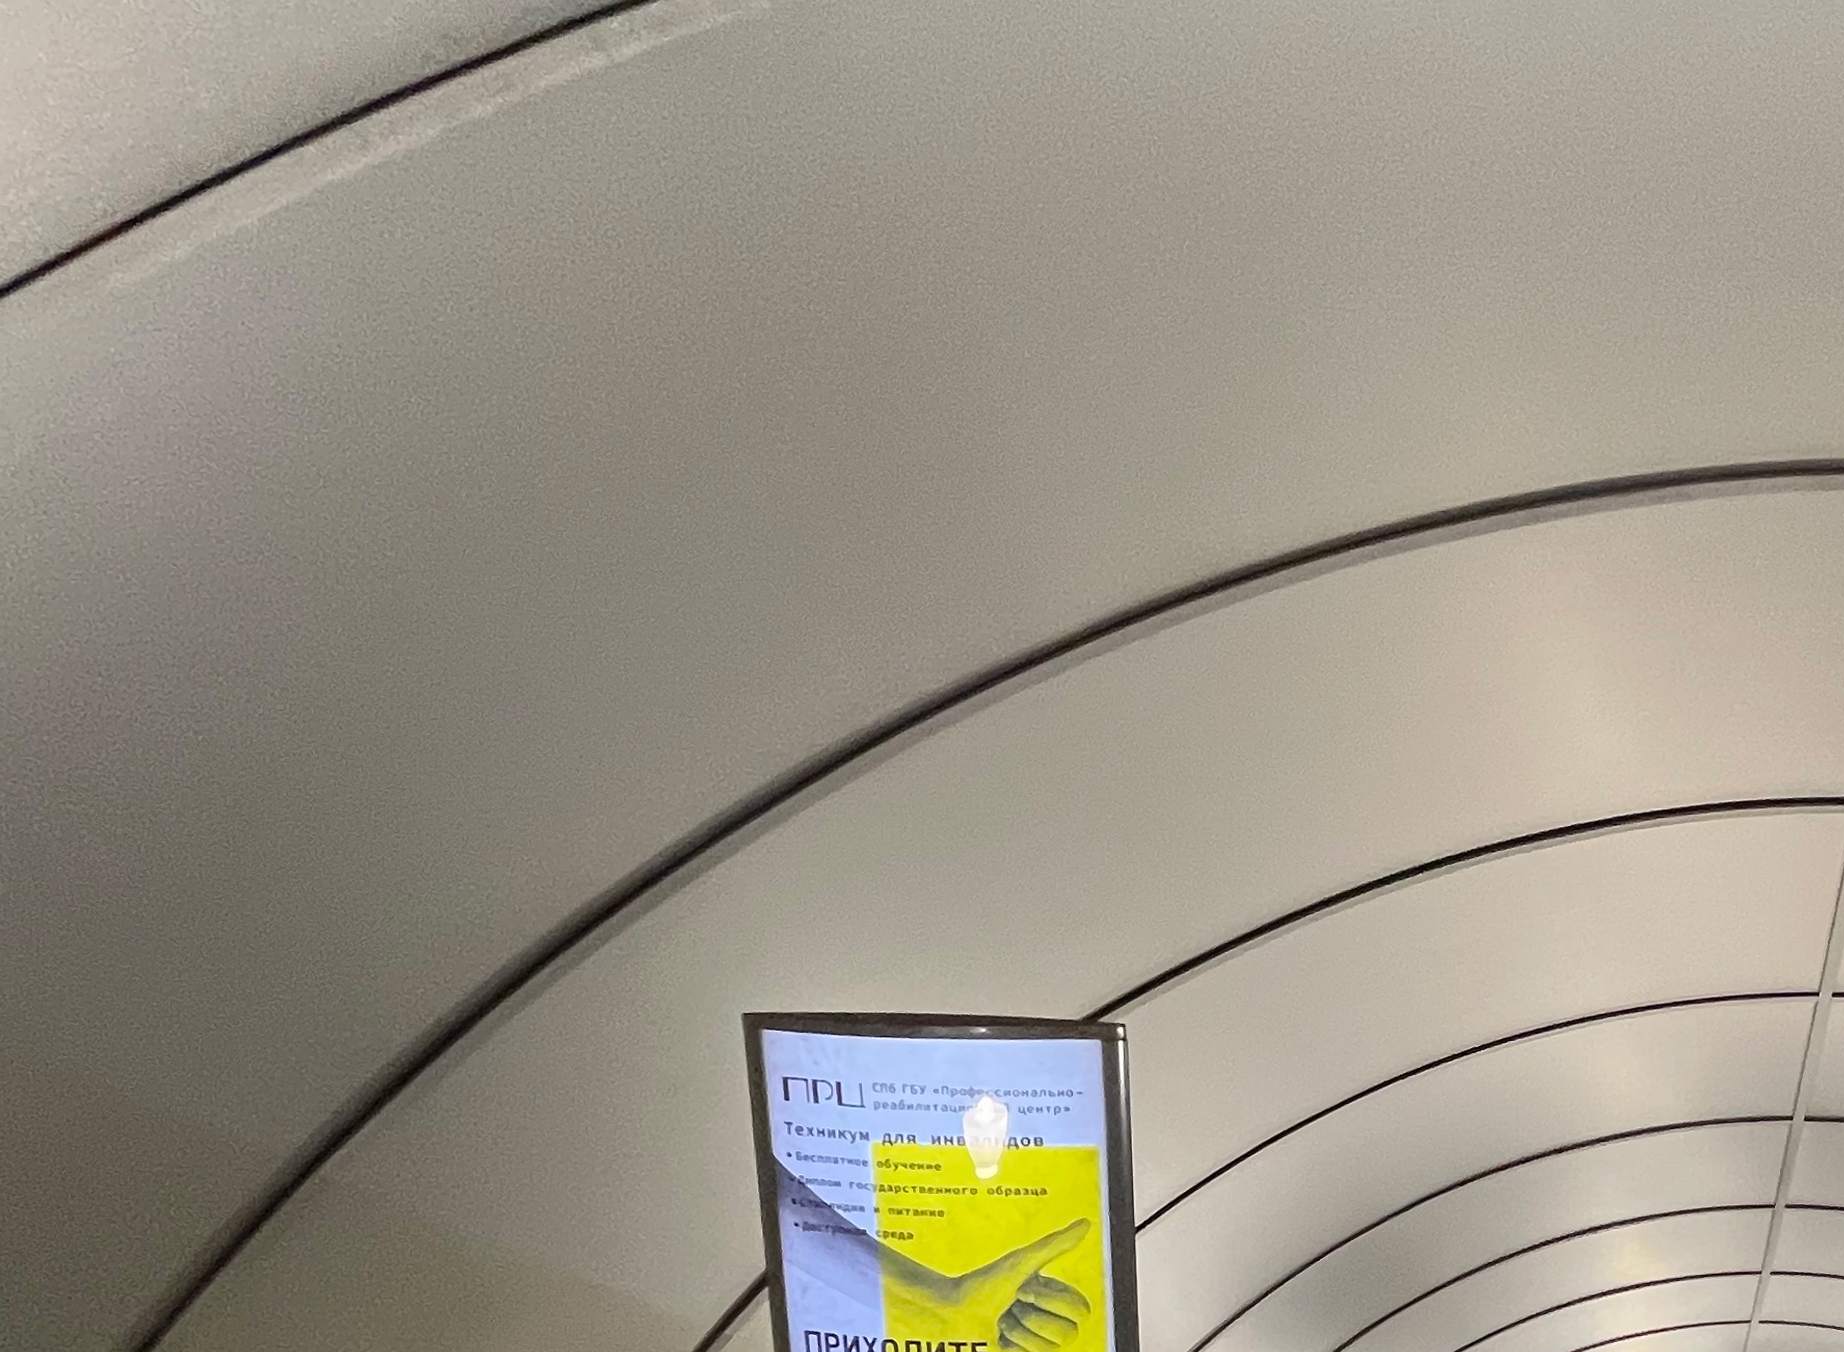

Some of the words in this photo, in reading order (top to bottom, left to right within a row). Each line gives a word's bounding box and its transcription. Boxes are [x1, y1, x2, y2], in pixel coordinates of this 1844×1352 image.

[782, 1076, 866, 1108] ПРЦ
[872, 1082, 896, 1094] СПб
[902, 1083, 927, 1095] ГБУ
[784, 1121, 870, 1144] Техникум
[882, 1132, 917, 1147] для
[931, 1134, 1045, 1150] инвдов
[876, 1159, 942, 1172] обучение
[987, 1185, 1048, 1197] образца
